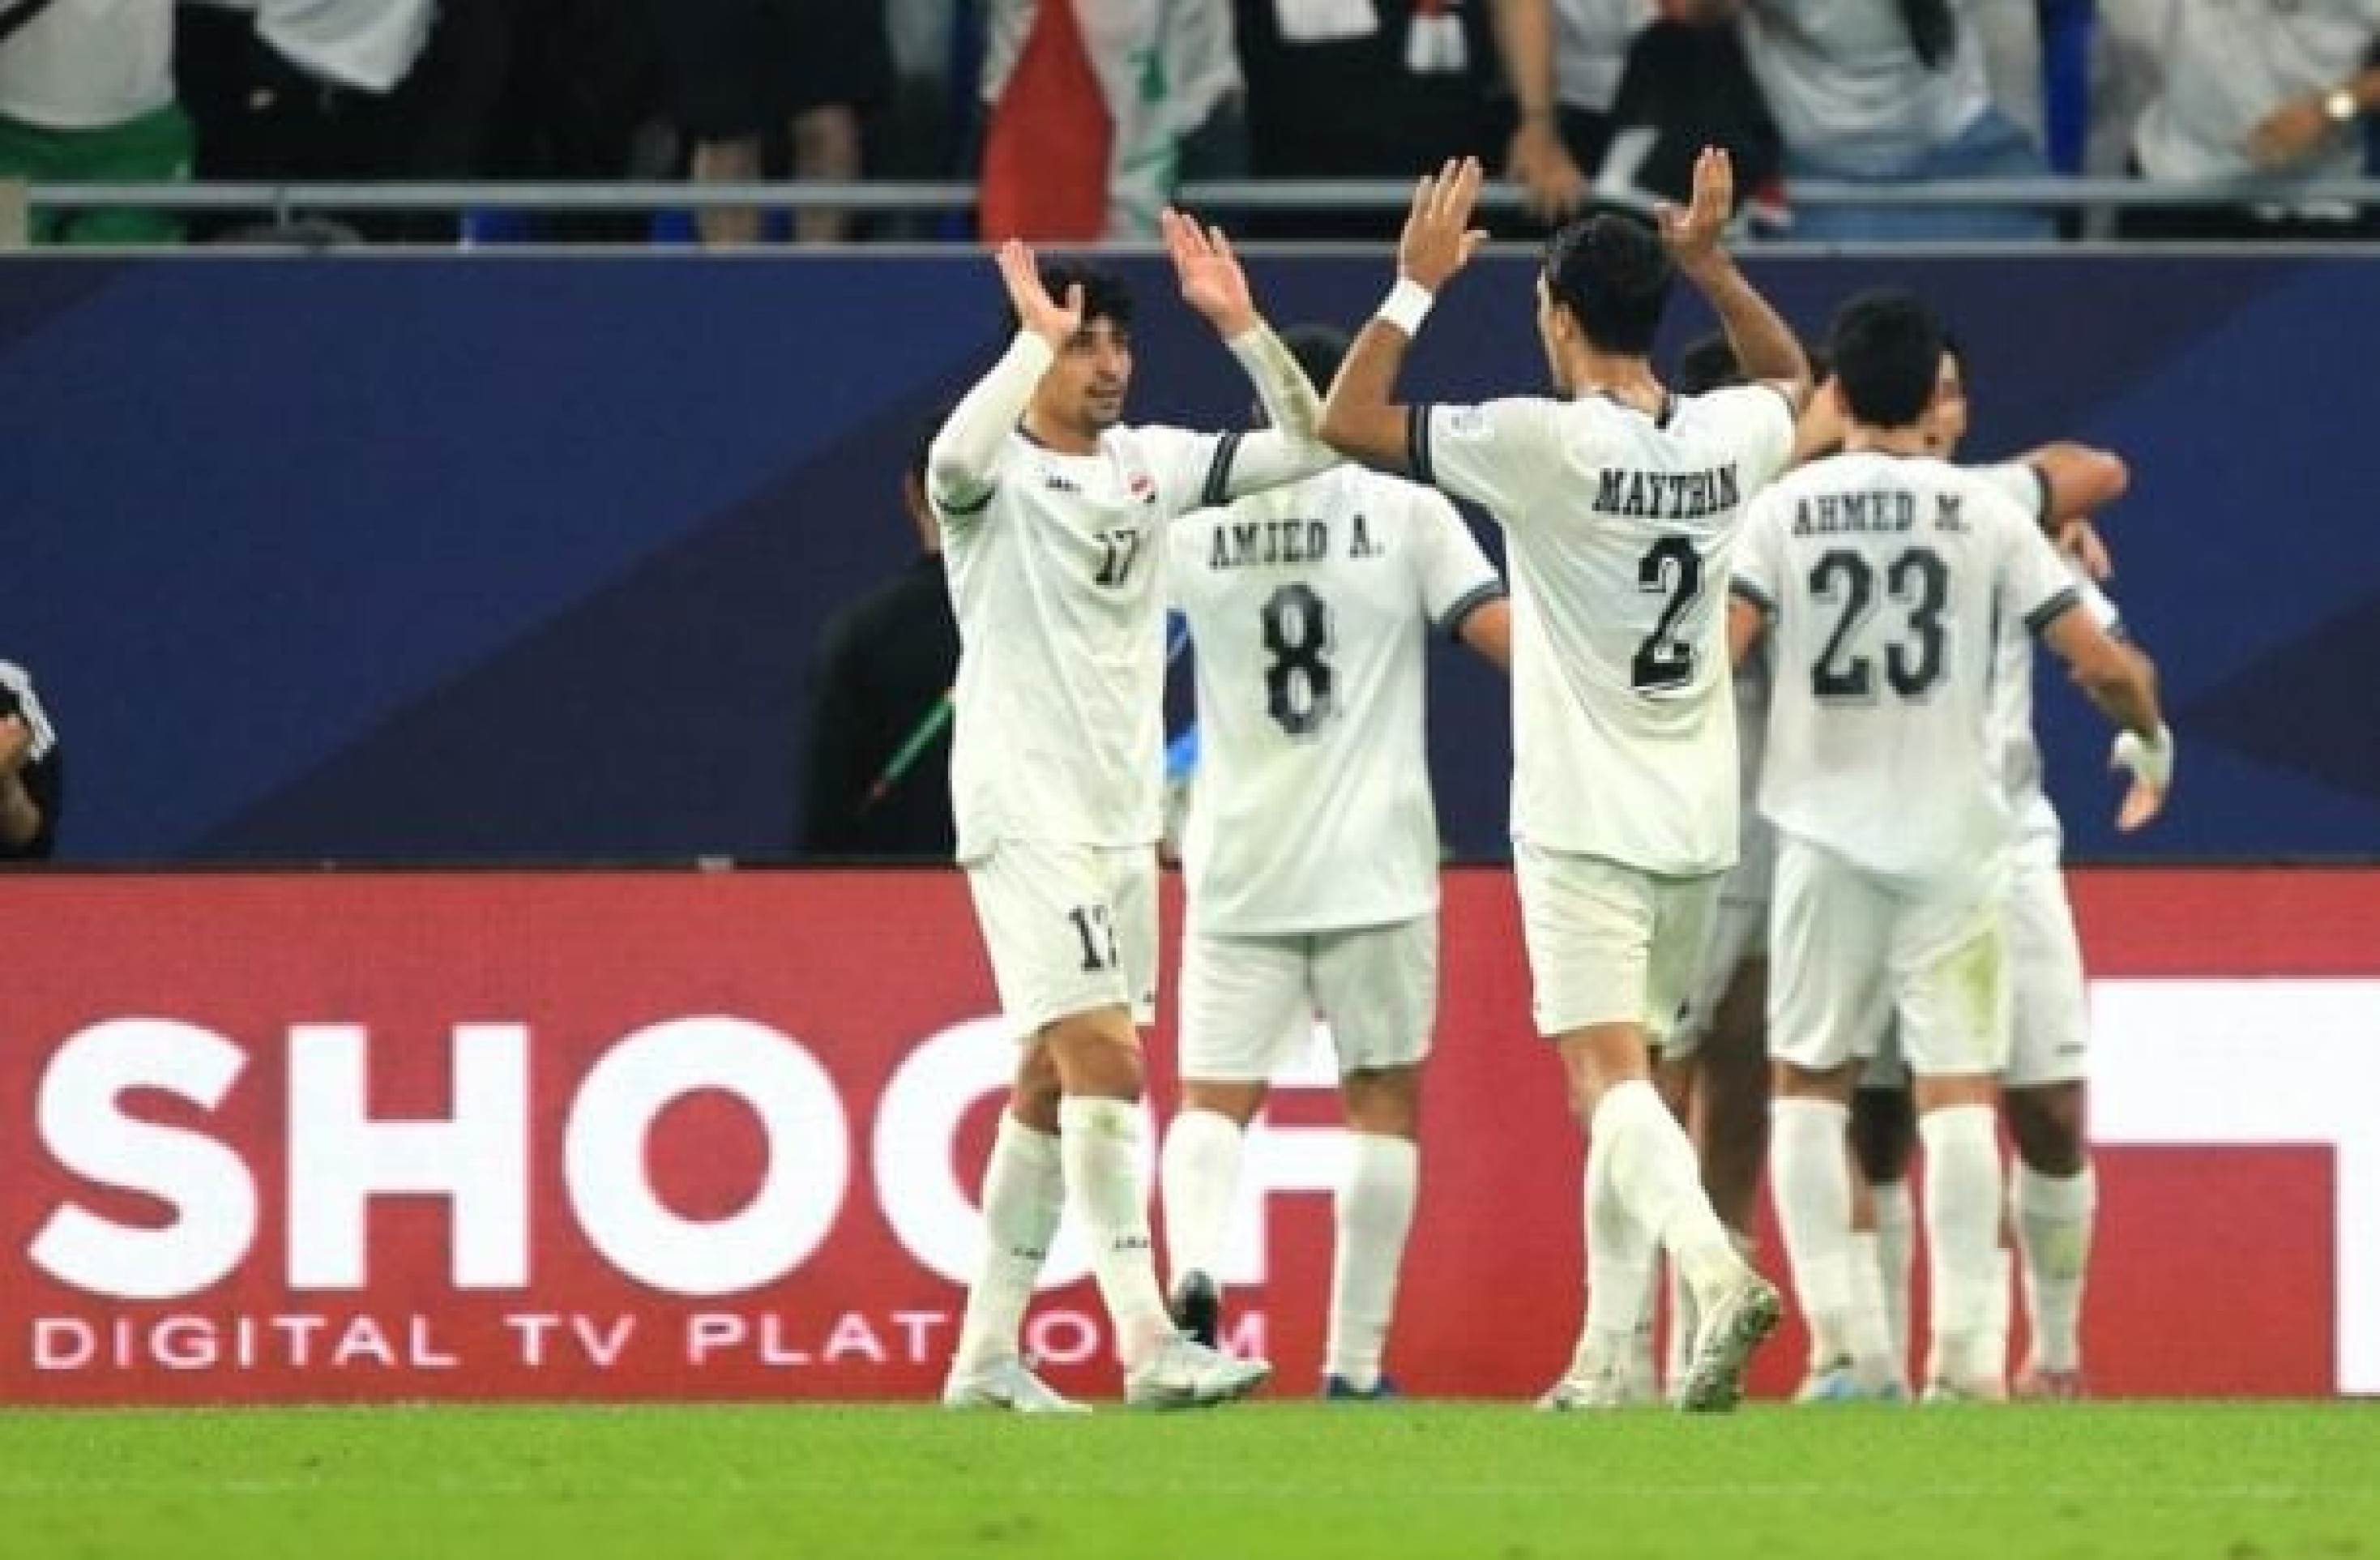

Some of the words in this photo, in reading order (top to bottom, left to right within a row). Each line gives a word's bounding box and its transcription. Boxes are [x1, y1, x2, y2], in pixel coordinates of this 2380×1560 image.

[1791, 489, 1915, 537] AHMED
[1092, 528, 1141, 588] 17
[1208, 518, 1330, 569] AMJED
[1631, 534, 1706, 689] 2
[1807, 547, 1952, 704] 23
[1261, 582, 1341, 737] 8
[31, 1314, 461, 1370] DIGITAL
[506, 1314, 637, 1368] TV
[686, 1311, 1267, 1366] PLATOM
